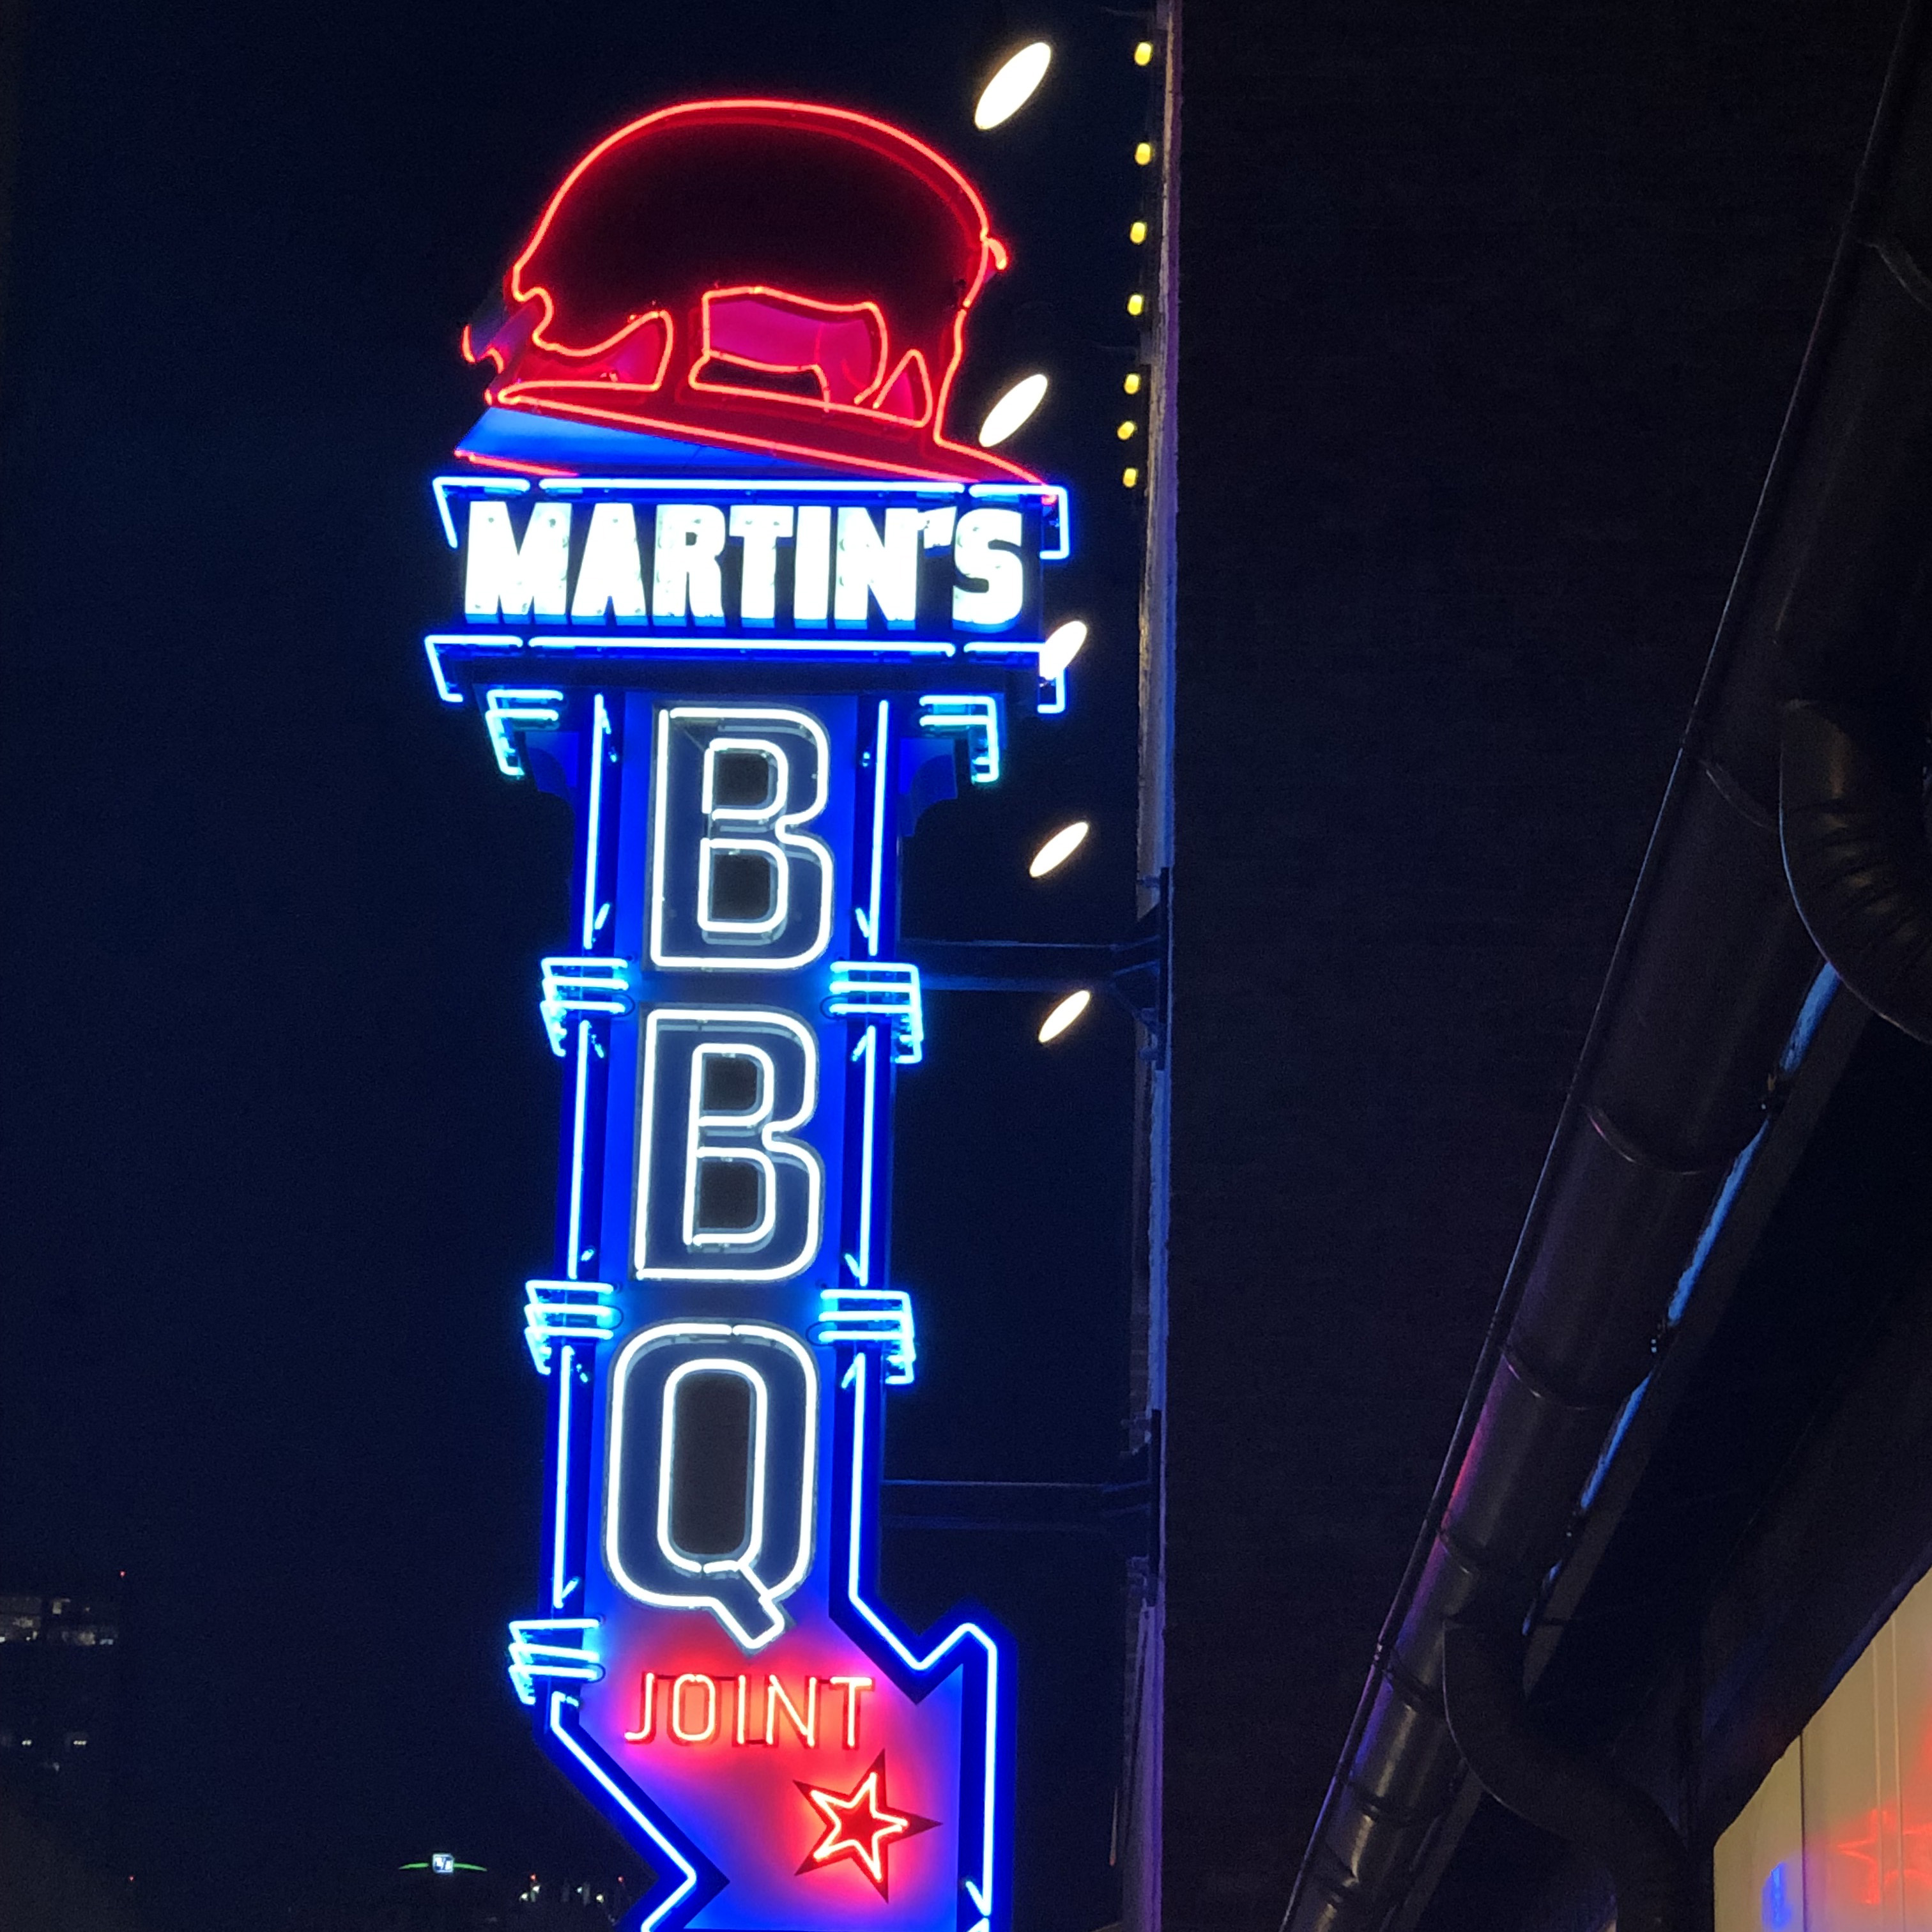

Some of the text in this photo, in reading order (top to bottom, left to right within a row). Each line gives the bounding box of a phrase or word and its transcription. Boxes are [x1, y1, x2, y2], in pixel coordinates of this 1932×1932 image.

[464, 500, 1024, 630] MARTIN'S
[603, 706, 835, 1653] BBQ
[625, 1672, 874, 1749] JOINT
